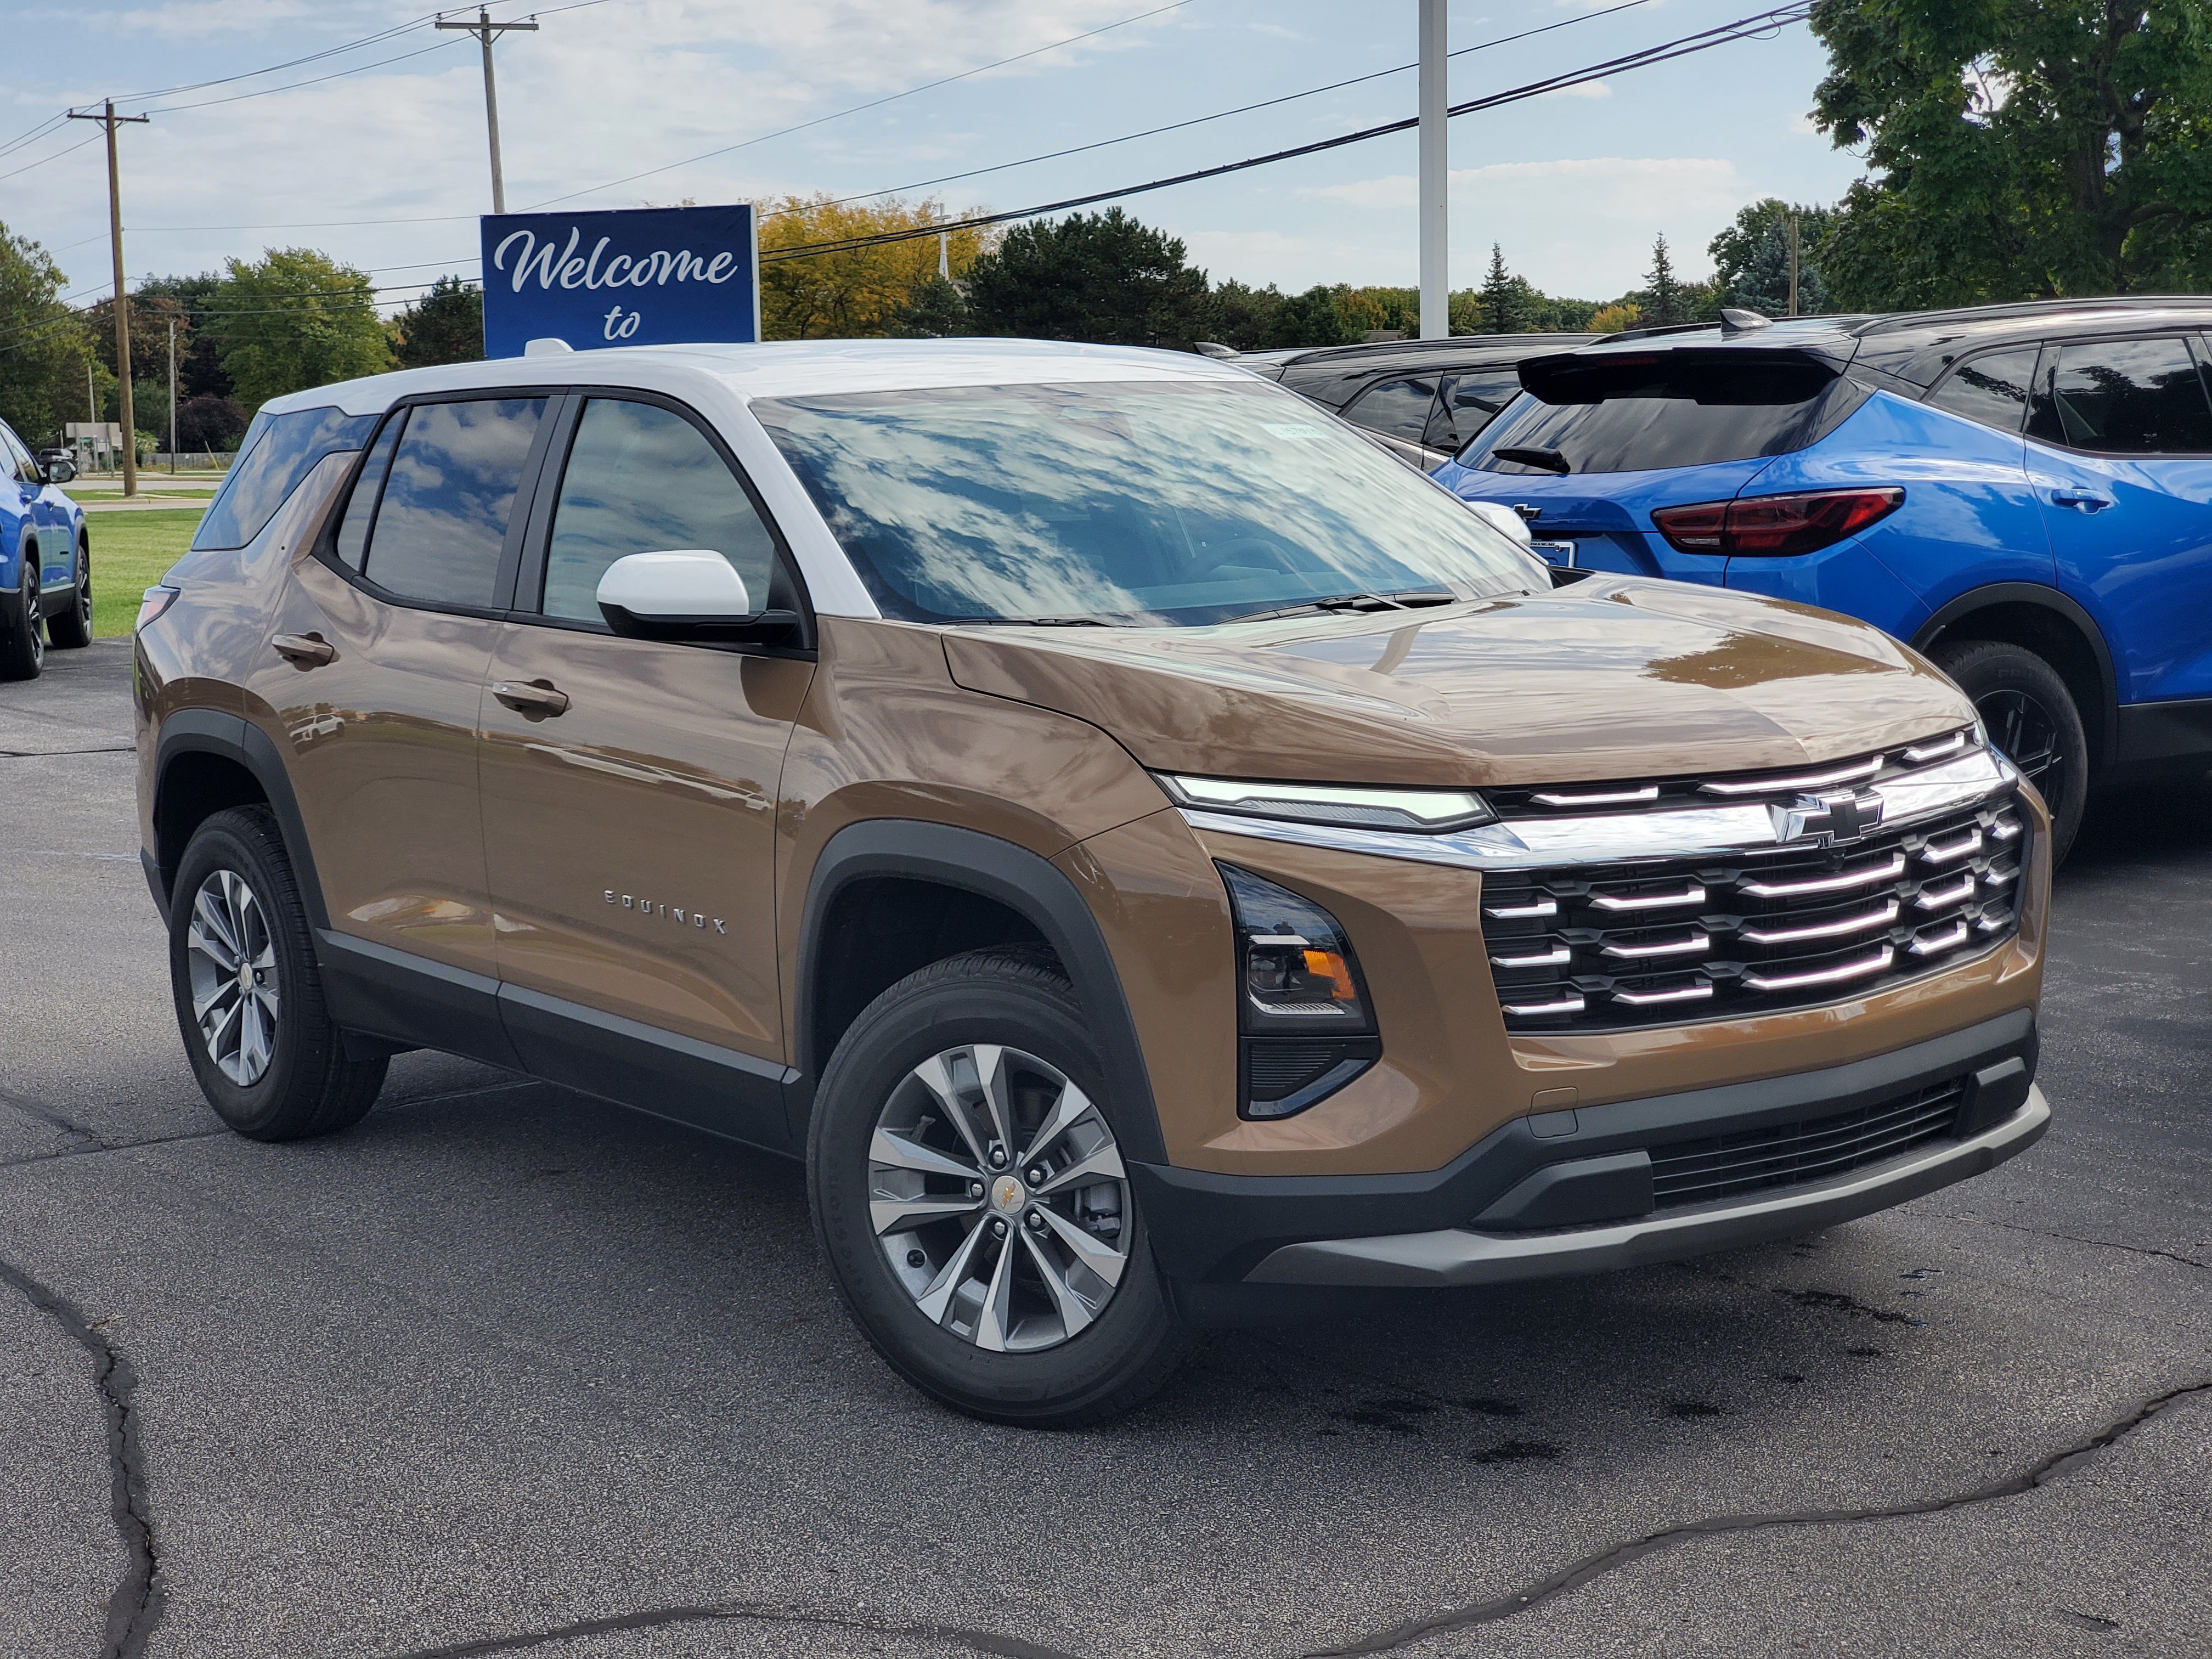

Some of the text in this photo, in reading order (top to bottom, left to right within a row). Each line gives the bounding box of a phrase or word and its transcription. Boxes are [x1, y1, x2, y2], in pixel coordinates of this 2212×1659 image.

[494, 226, 738, 292] Welcome
[603, 305, 640, 340] to
[604, 890, 726, 934] EQUINOX
